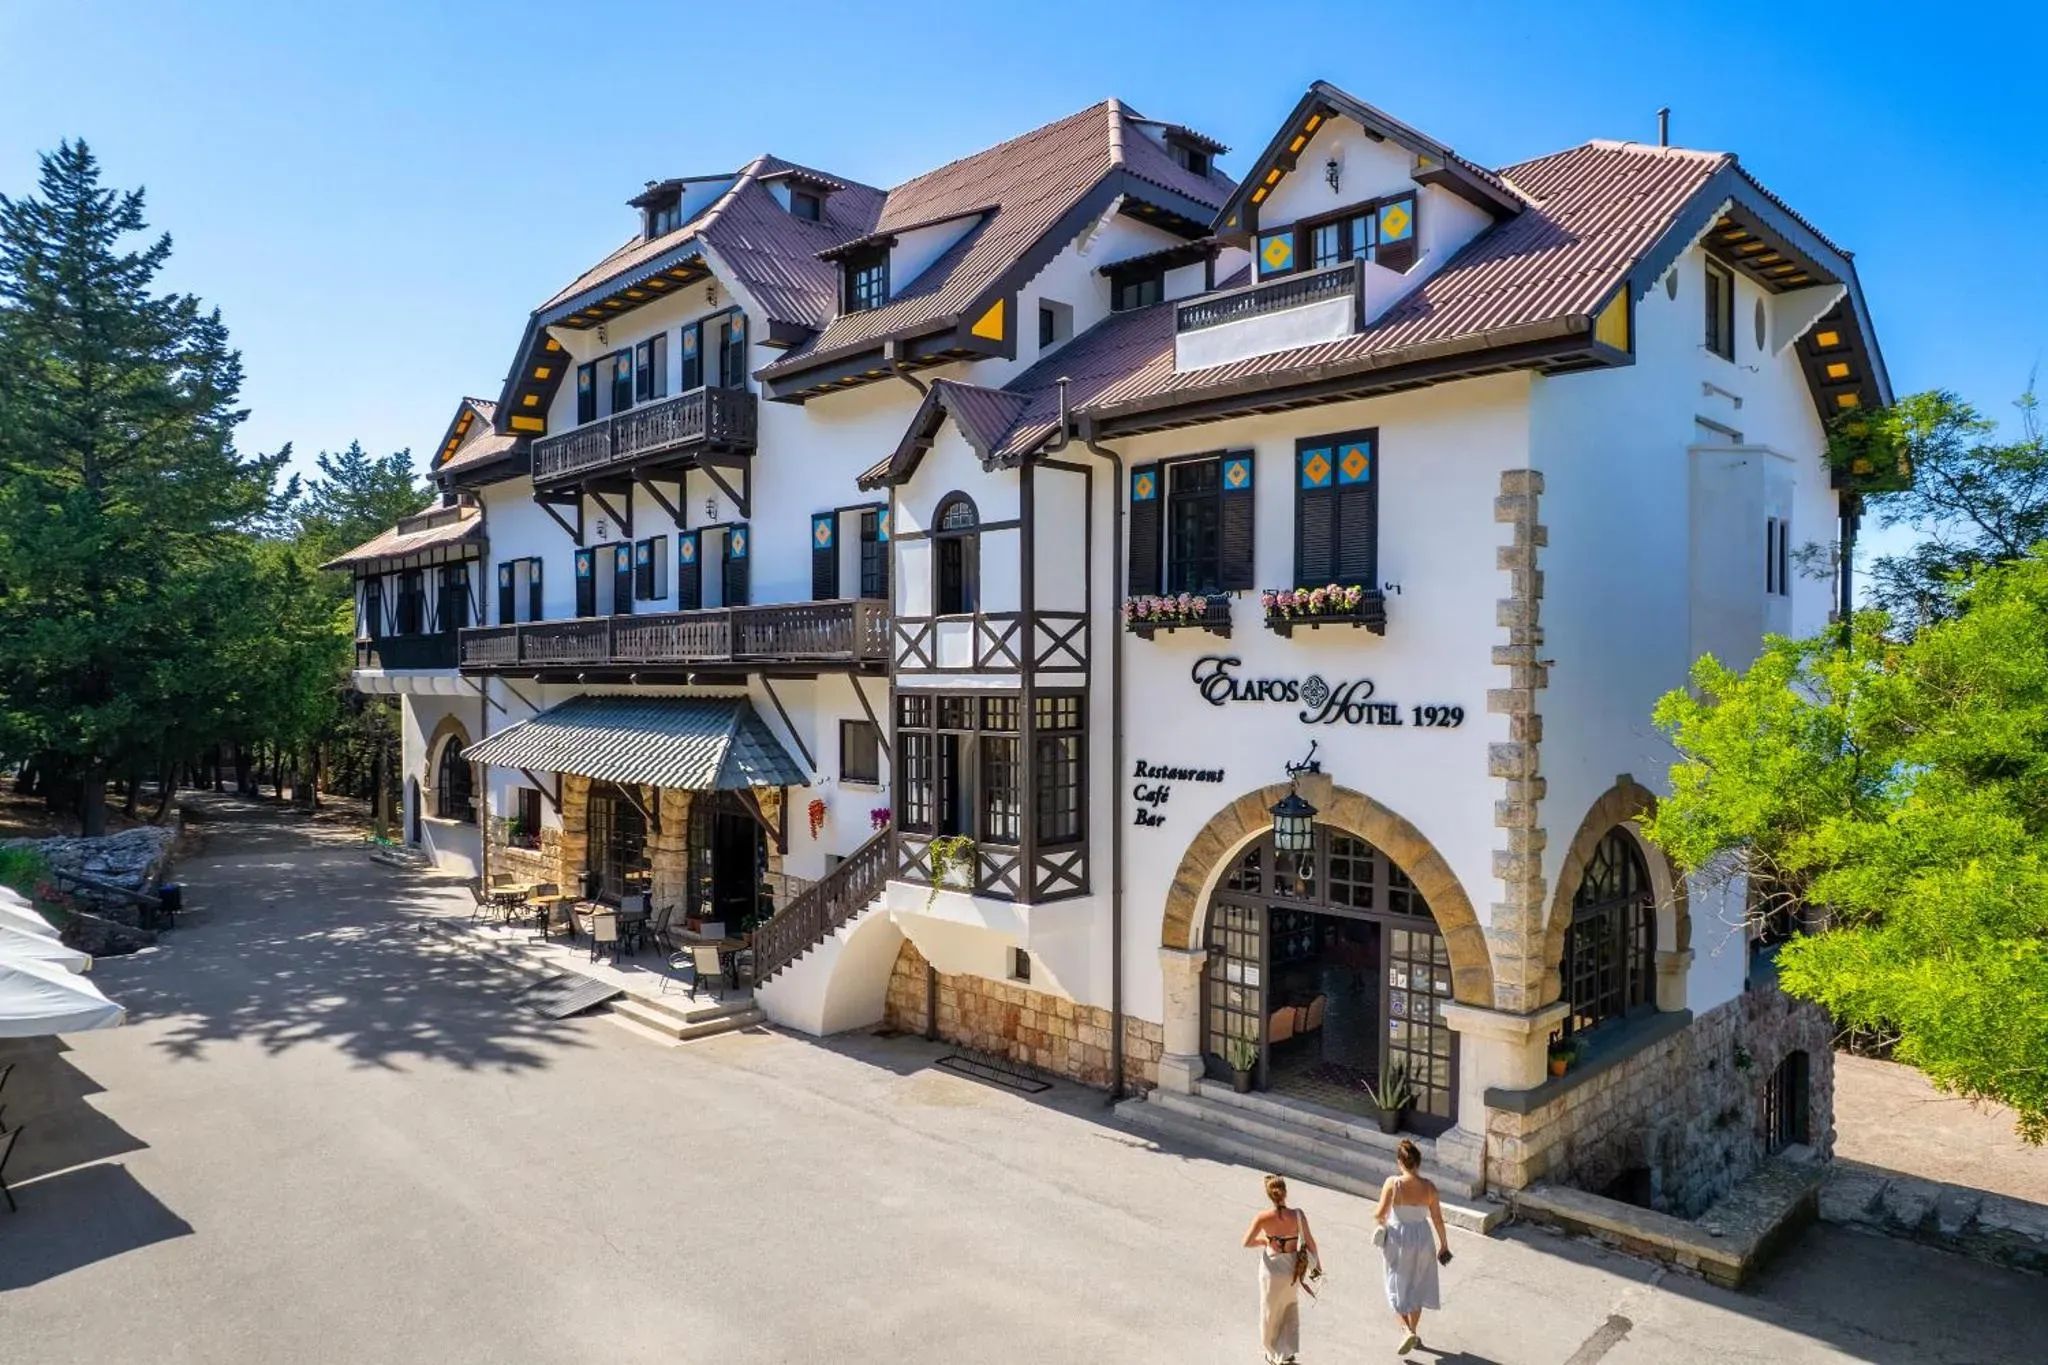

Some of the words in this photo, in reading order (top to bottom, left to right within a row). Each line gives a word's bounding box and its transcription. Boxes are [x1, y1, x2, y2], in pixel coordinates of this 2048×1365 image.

[1191, 656, 1299, 706] ELAFOS
[1300, 680, 1403, 726] HOTEL
[1412, 706, 1465, 728] 1929
[1133, 760, 1225, 783] Restaurant
[1133, 784, 1169, 807] Café
[1133, 807, 1167, 828] Bar
